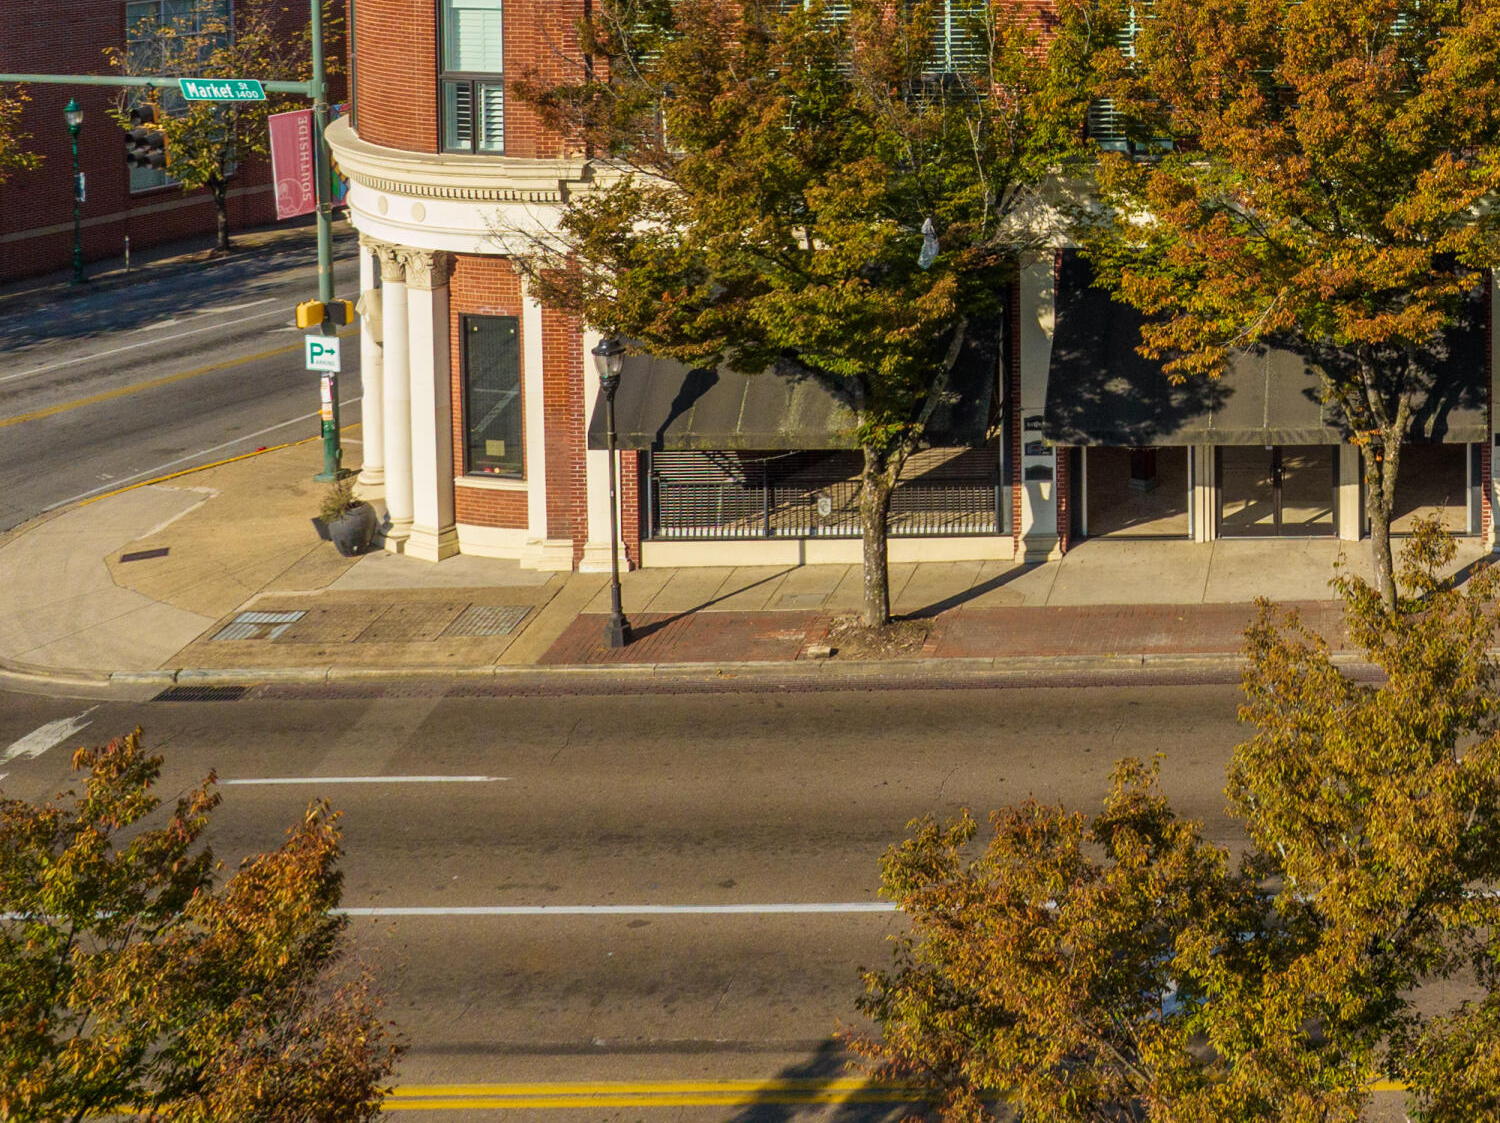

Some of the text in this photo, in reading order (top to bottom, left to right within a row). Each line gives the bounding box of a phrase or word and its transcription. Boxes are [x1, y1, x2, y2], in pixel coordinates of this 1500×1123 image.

[186, 82, 249, 98] Market St
[236, 90, 259, 98] 1400
[298, 116, 312, 201] SOUTHSIDE
